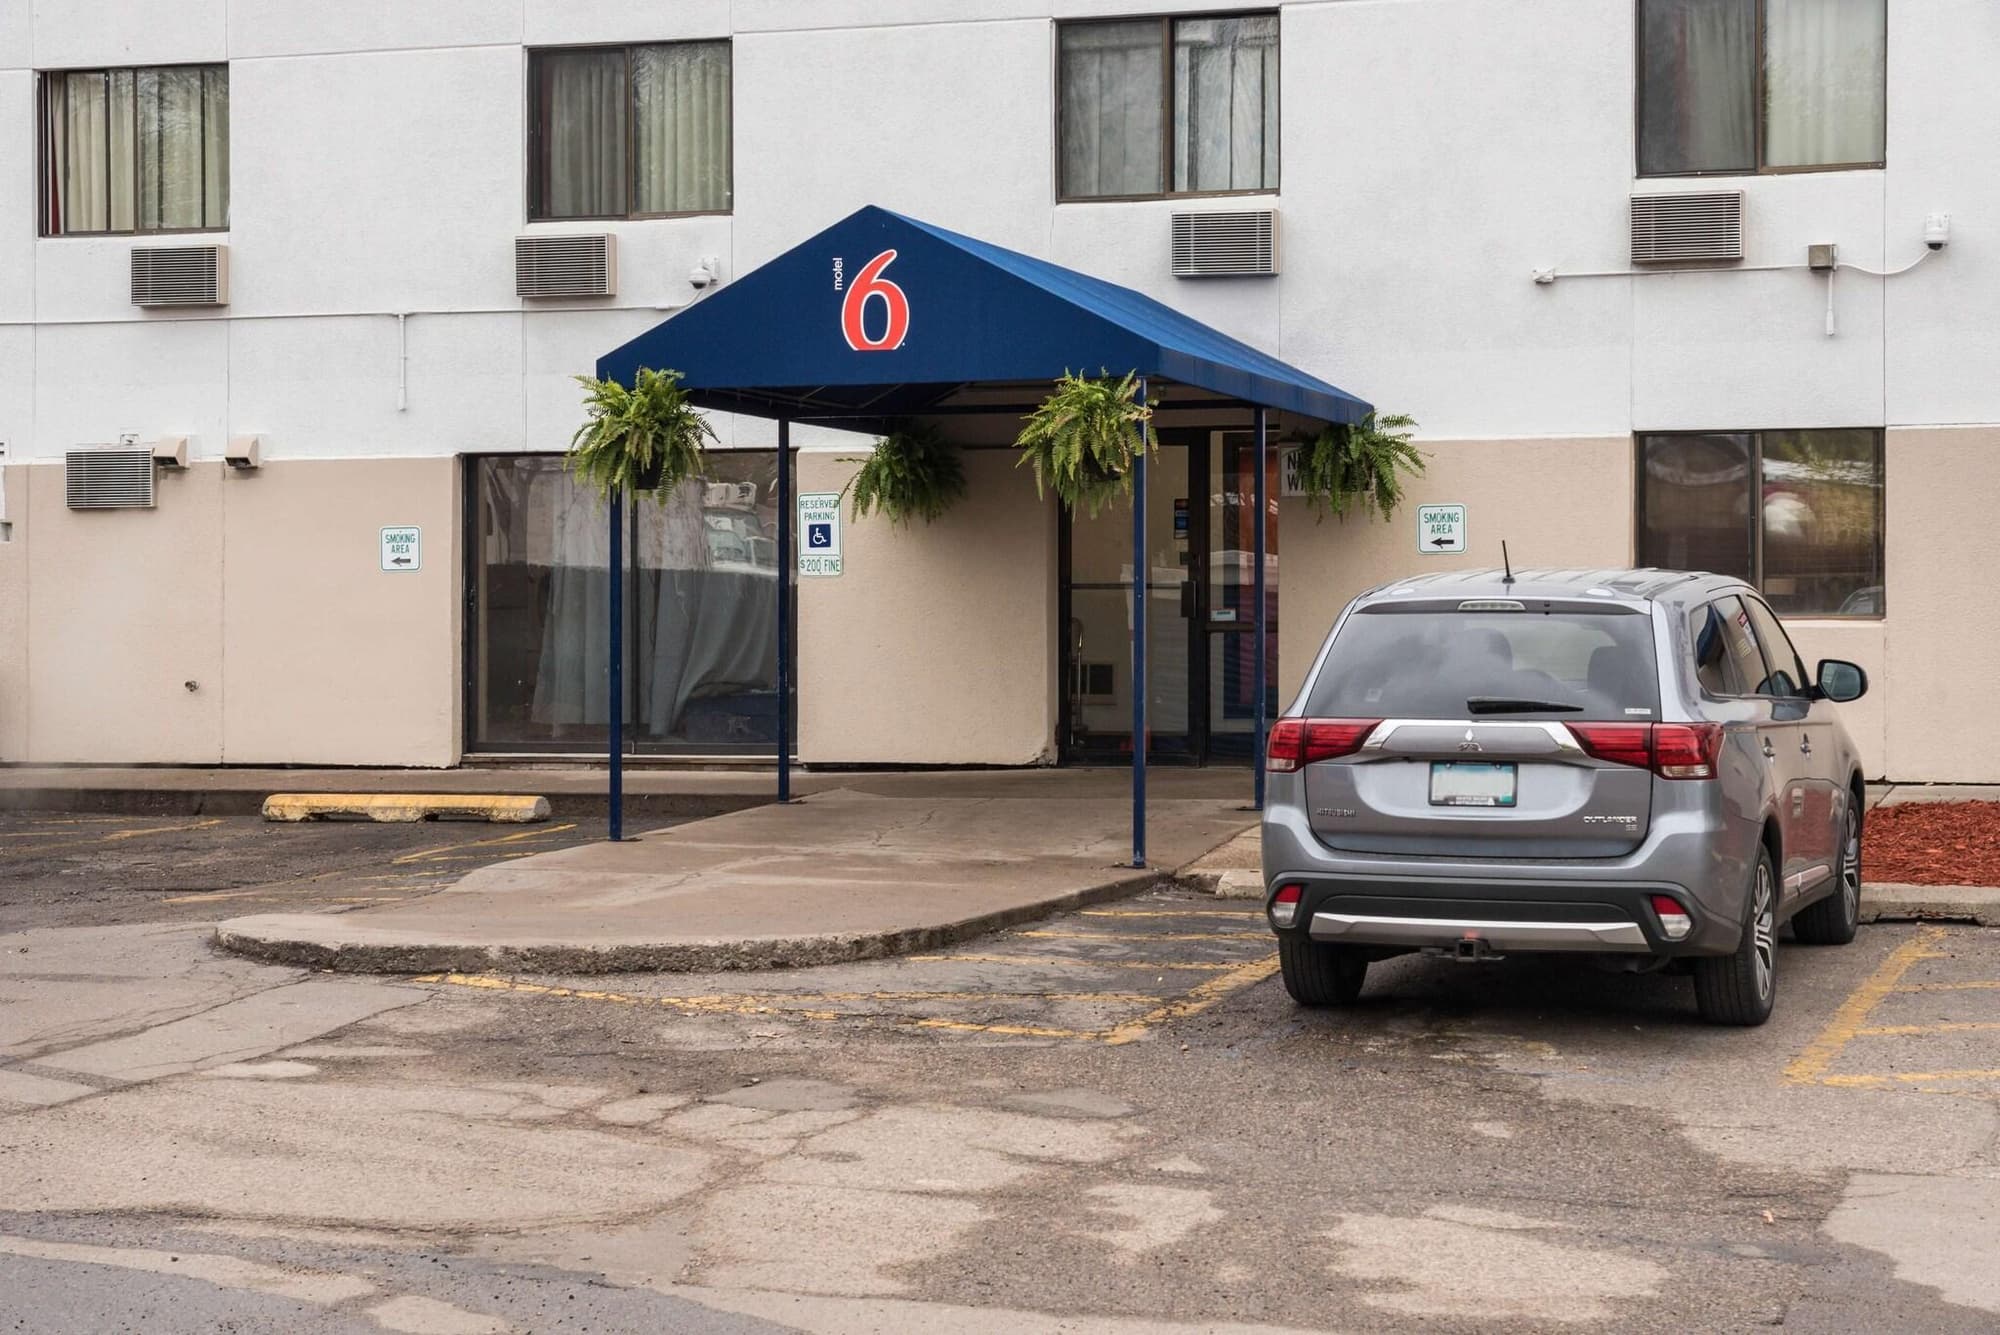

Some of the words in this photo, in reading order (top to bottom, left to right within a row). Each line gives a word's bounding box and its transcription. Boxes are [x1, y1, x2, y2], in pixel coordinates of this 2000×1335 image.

[832, 257, 843, 290] motel
[841, 248, 910, 351] 6
[800, 499, 840, 509] RESERVED
[804, 511, 835, 521] PARKING
[1424, 512, 1460, 524] SMOKING
[1431, 524, 1453, 535] AREA
[385, 533, 416, 544] SMOKING
[391, 544, 410, 554] AREA
[800, 559, 821, 572] $200
[824, 560, 840, 572] FINE
[1583, 816, 1637, 824] OUTLANDER
